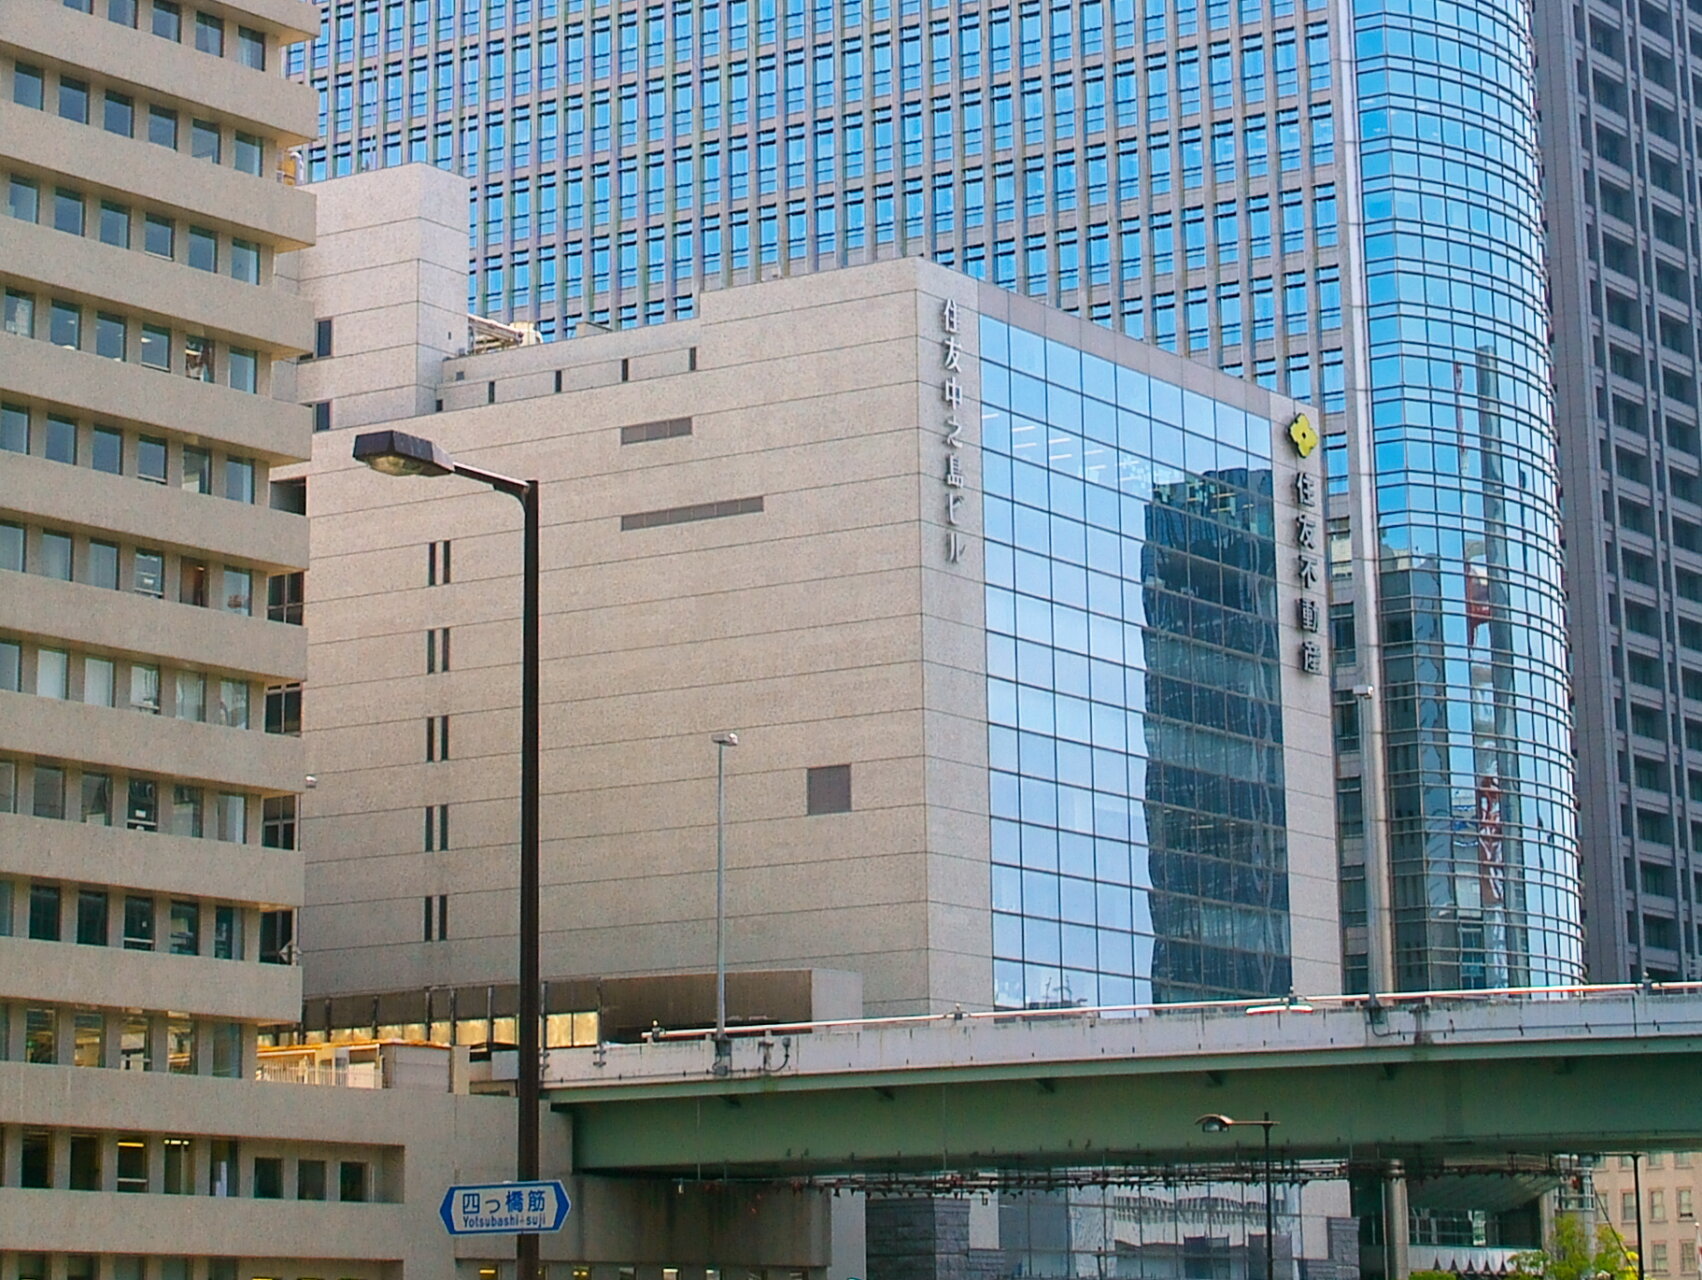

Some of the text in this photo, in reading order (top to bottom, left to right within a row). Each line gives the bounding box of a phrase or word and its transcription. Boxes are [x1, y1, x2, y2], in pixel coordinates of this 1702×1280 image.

[944, 298, 965, 563] 住友中之島ビル
[1297, 472, 1322, 674] 住友不動産
[462, 1190, 546, 1214] 四つ橋筋
